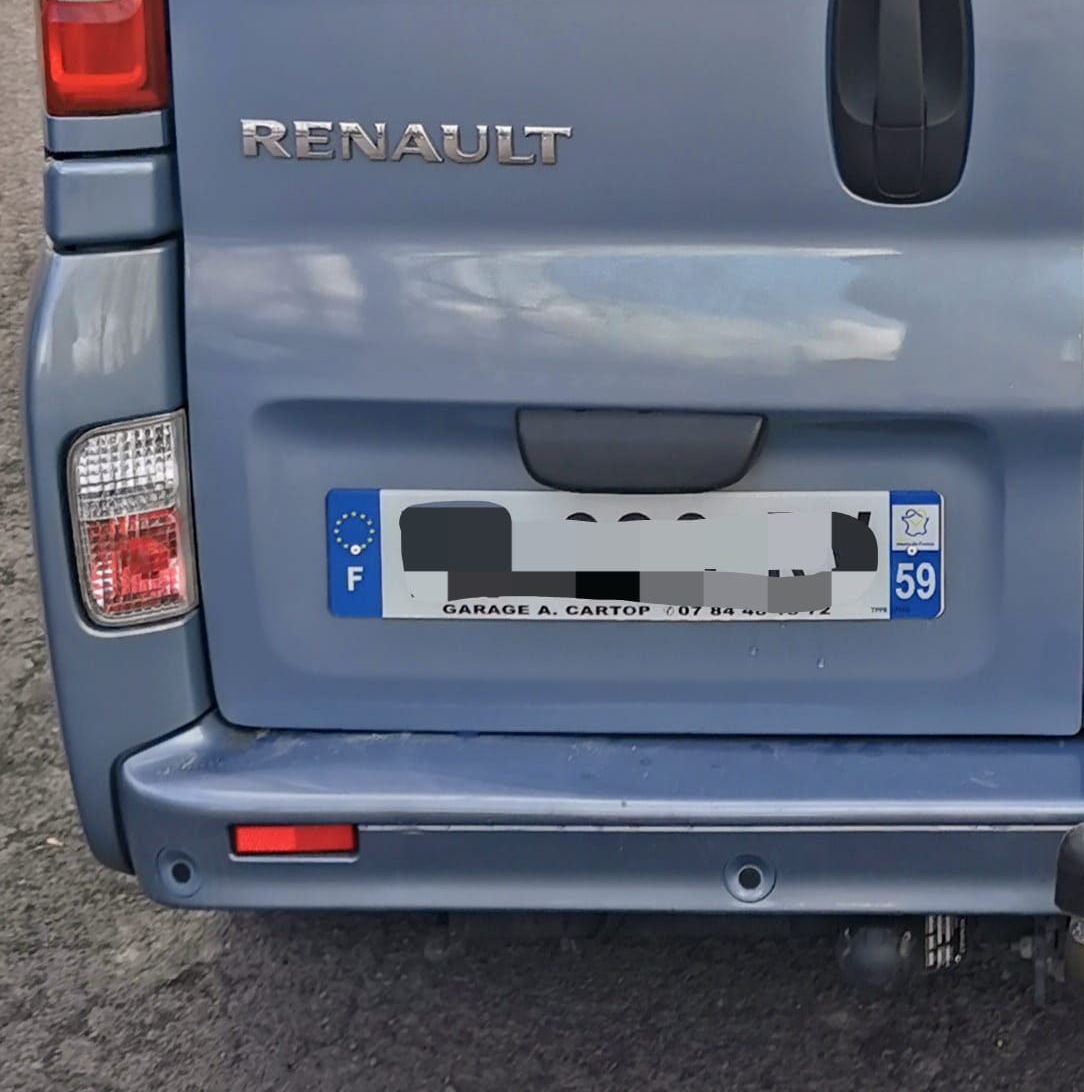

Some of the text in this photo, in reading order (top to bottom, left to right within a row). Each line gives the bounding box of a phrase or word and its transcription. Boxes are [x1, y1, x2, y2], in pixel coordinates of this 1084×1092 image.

[240, 118, 574, 165] RENAULT
[346, 566, 364, 592] F
[895, 561, 936, 600] 59
[442, 604, 530, 616] GARAGE
[537, 604, 558, 616] A.
[565, 604, 651, 616] CARTOP
[678, 606, 703, 616] 07
[710, 606, 735, 616] 84
